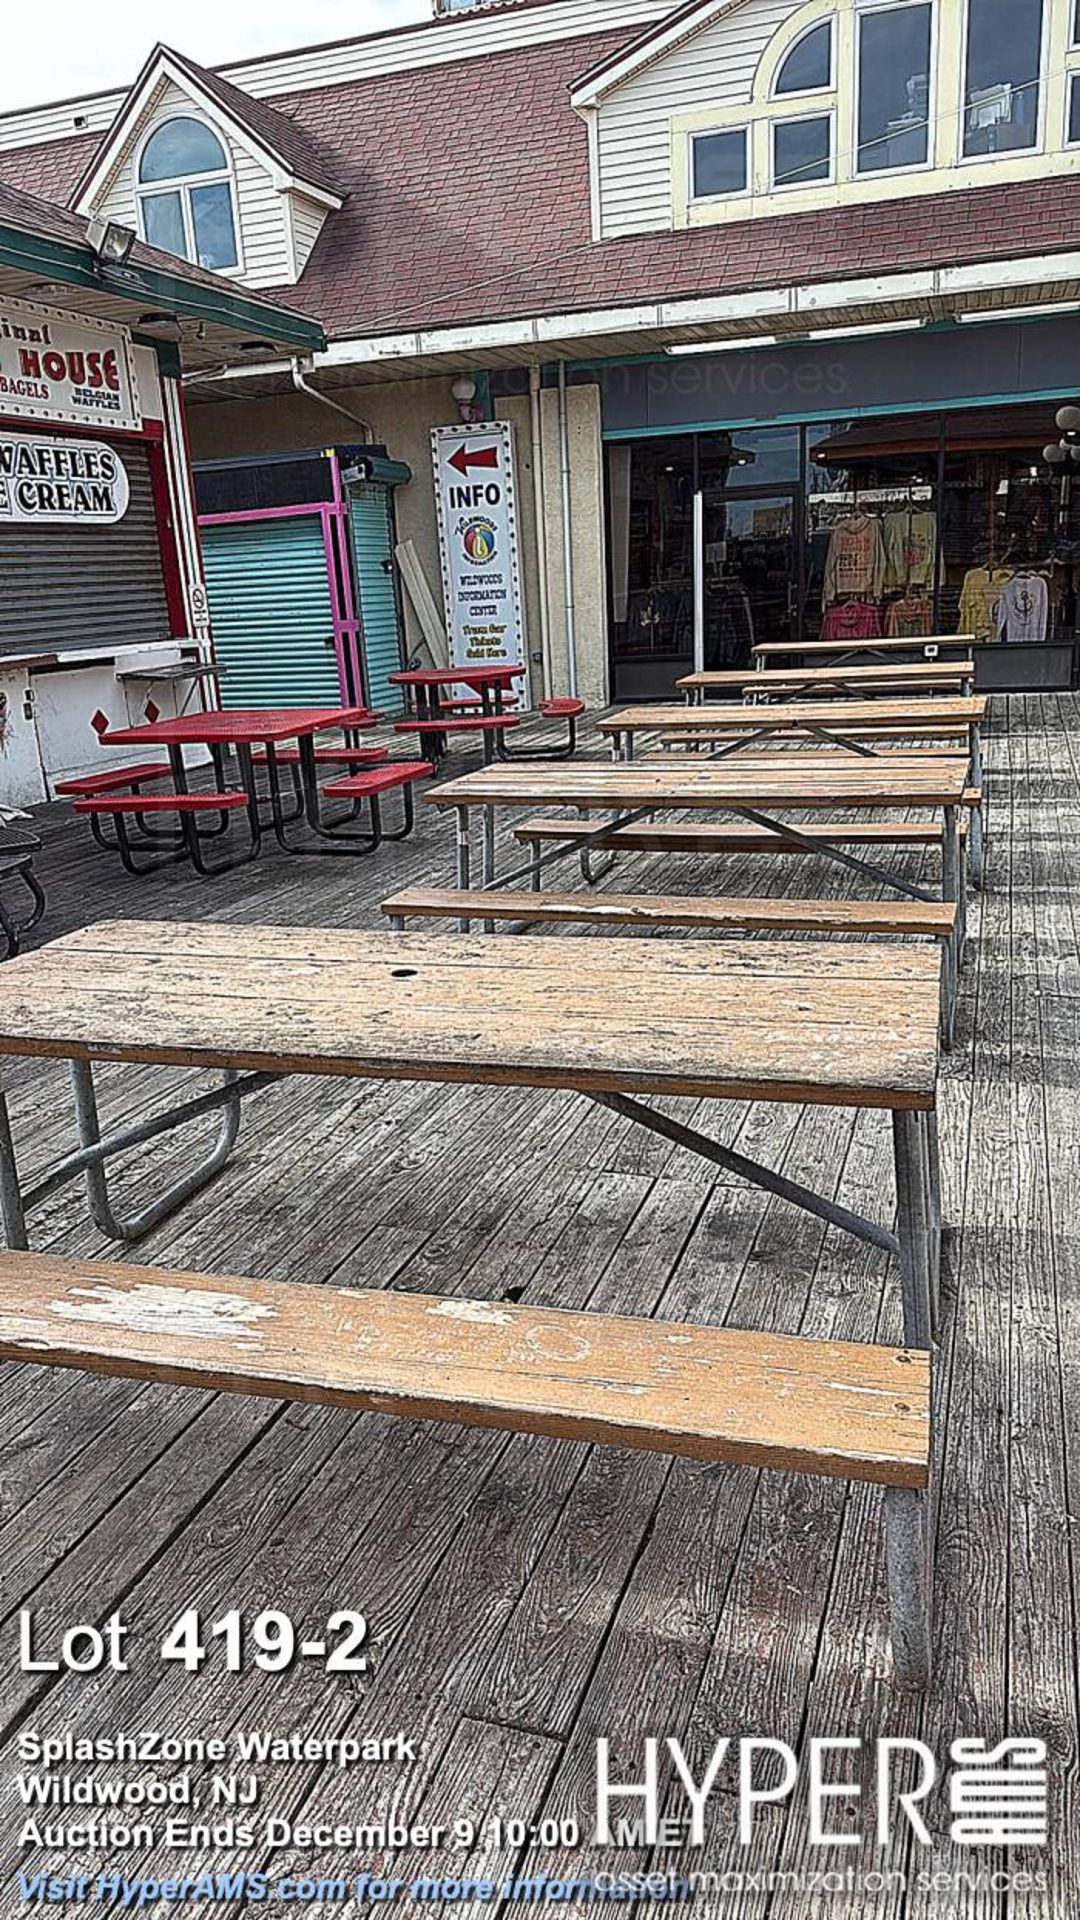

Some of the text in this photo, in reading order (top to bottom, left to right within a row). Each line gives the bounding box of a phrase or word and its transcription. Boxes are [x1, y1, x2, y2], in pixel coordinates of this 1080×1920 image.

[0, 317, 51, 345] inal
[18, 348, 120, 391] HOUSE
[0, 376, 49, 400] BAGELS
[74, 387, 120, 402] BELGIAN
[71, 395, 121, 410] WAFFLES
[18, 481, 115, 512] CREAM
[449, 483, 501, 509] INFO
[459, 573, 504, 586] WILDWOODS
[457, 589, 507, 602] INFORMATION
[469, 605, 498, 617] CENTER
